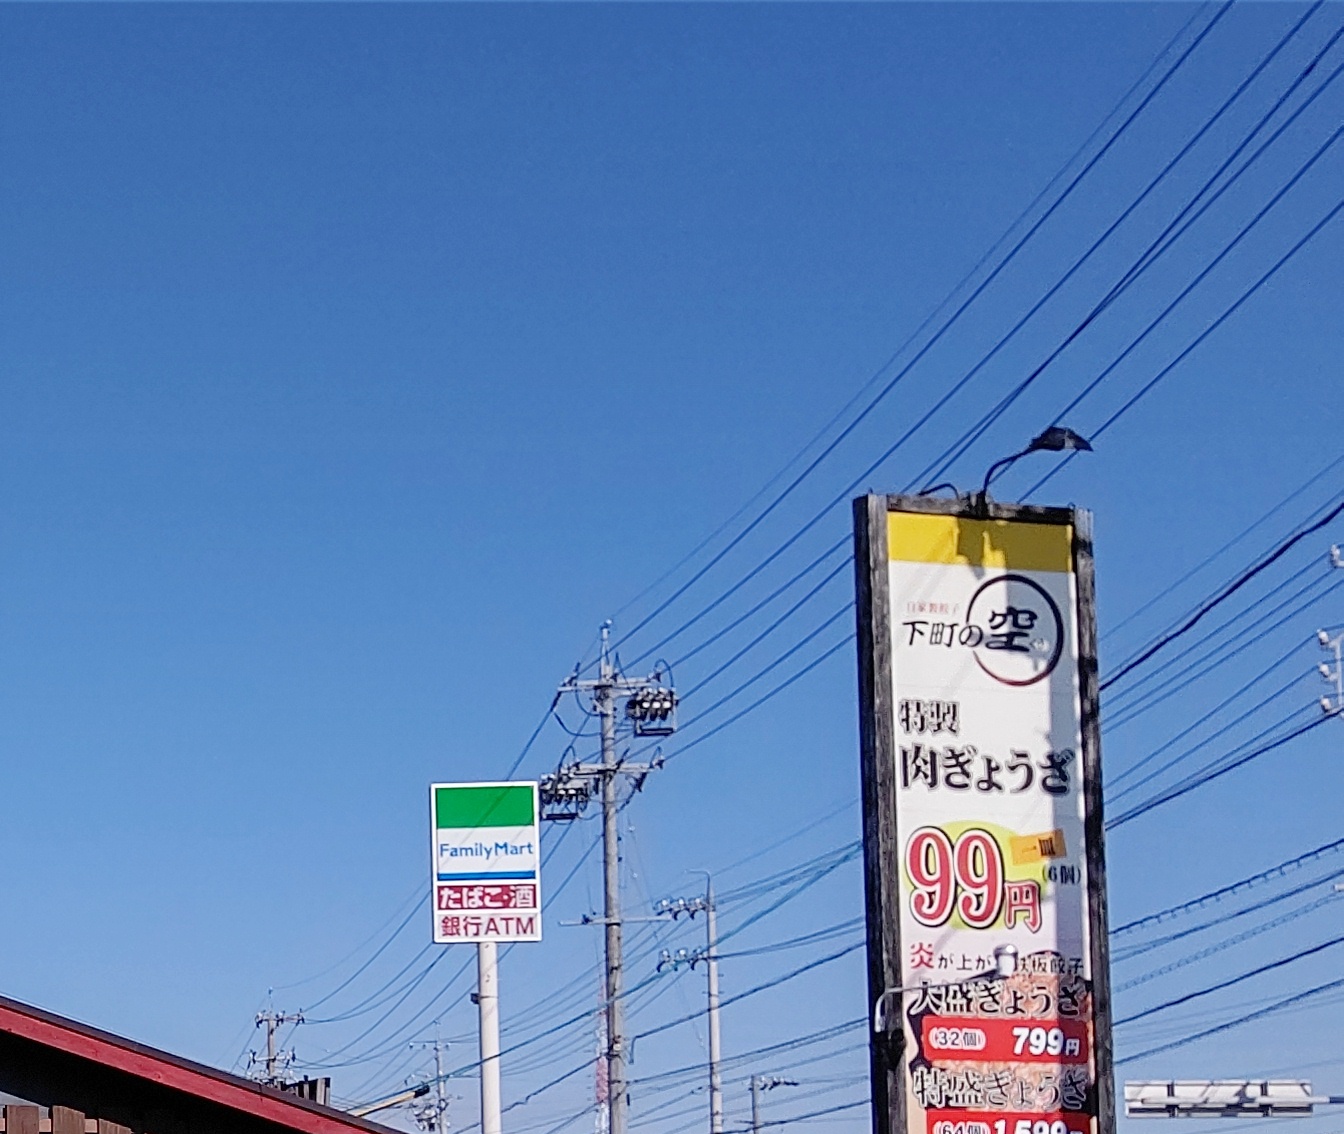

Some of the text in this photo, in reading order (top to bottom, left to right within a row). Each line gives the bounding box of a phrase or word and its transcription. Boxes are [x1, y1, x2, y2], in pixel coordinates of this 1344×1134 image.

[902, 606, 1038, 652] 下町の空
[899, 700, 960, 734] 特製
[899, 744, 1075, 797] 肉ぎょうざ
[440, 842, 533, 860] FamilyMart
[440, 885, 534, 909] たばこ・酒
[905, 826, 1042, 934] 99円
[441, 916, 534, 937] 銀行ATM
[910, 978, 1087, 1016] 大盛ぎょうざ
[1012, 1027, 1080, 1056] 799円
[913, 1066, 1089, 1111] 特盛ぎょうざ
